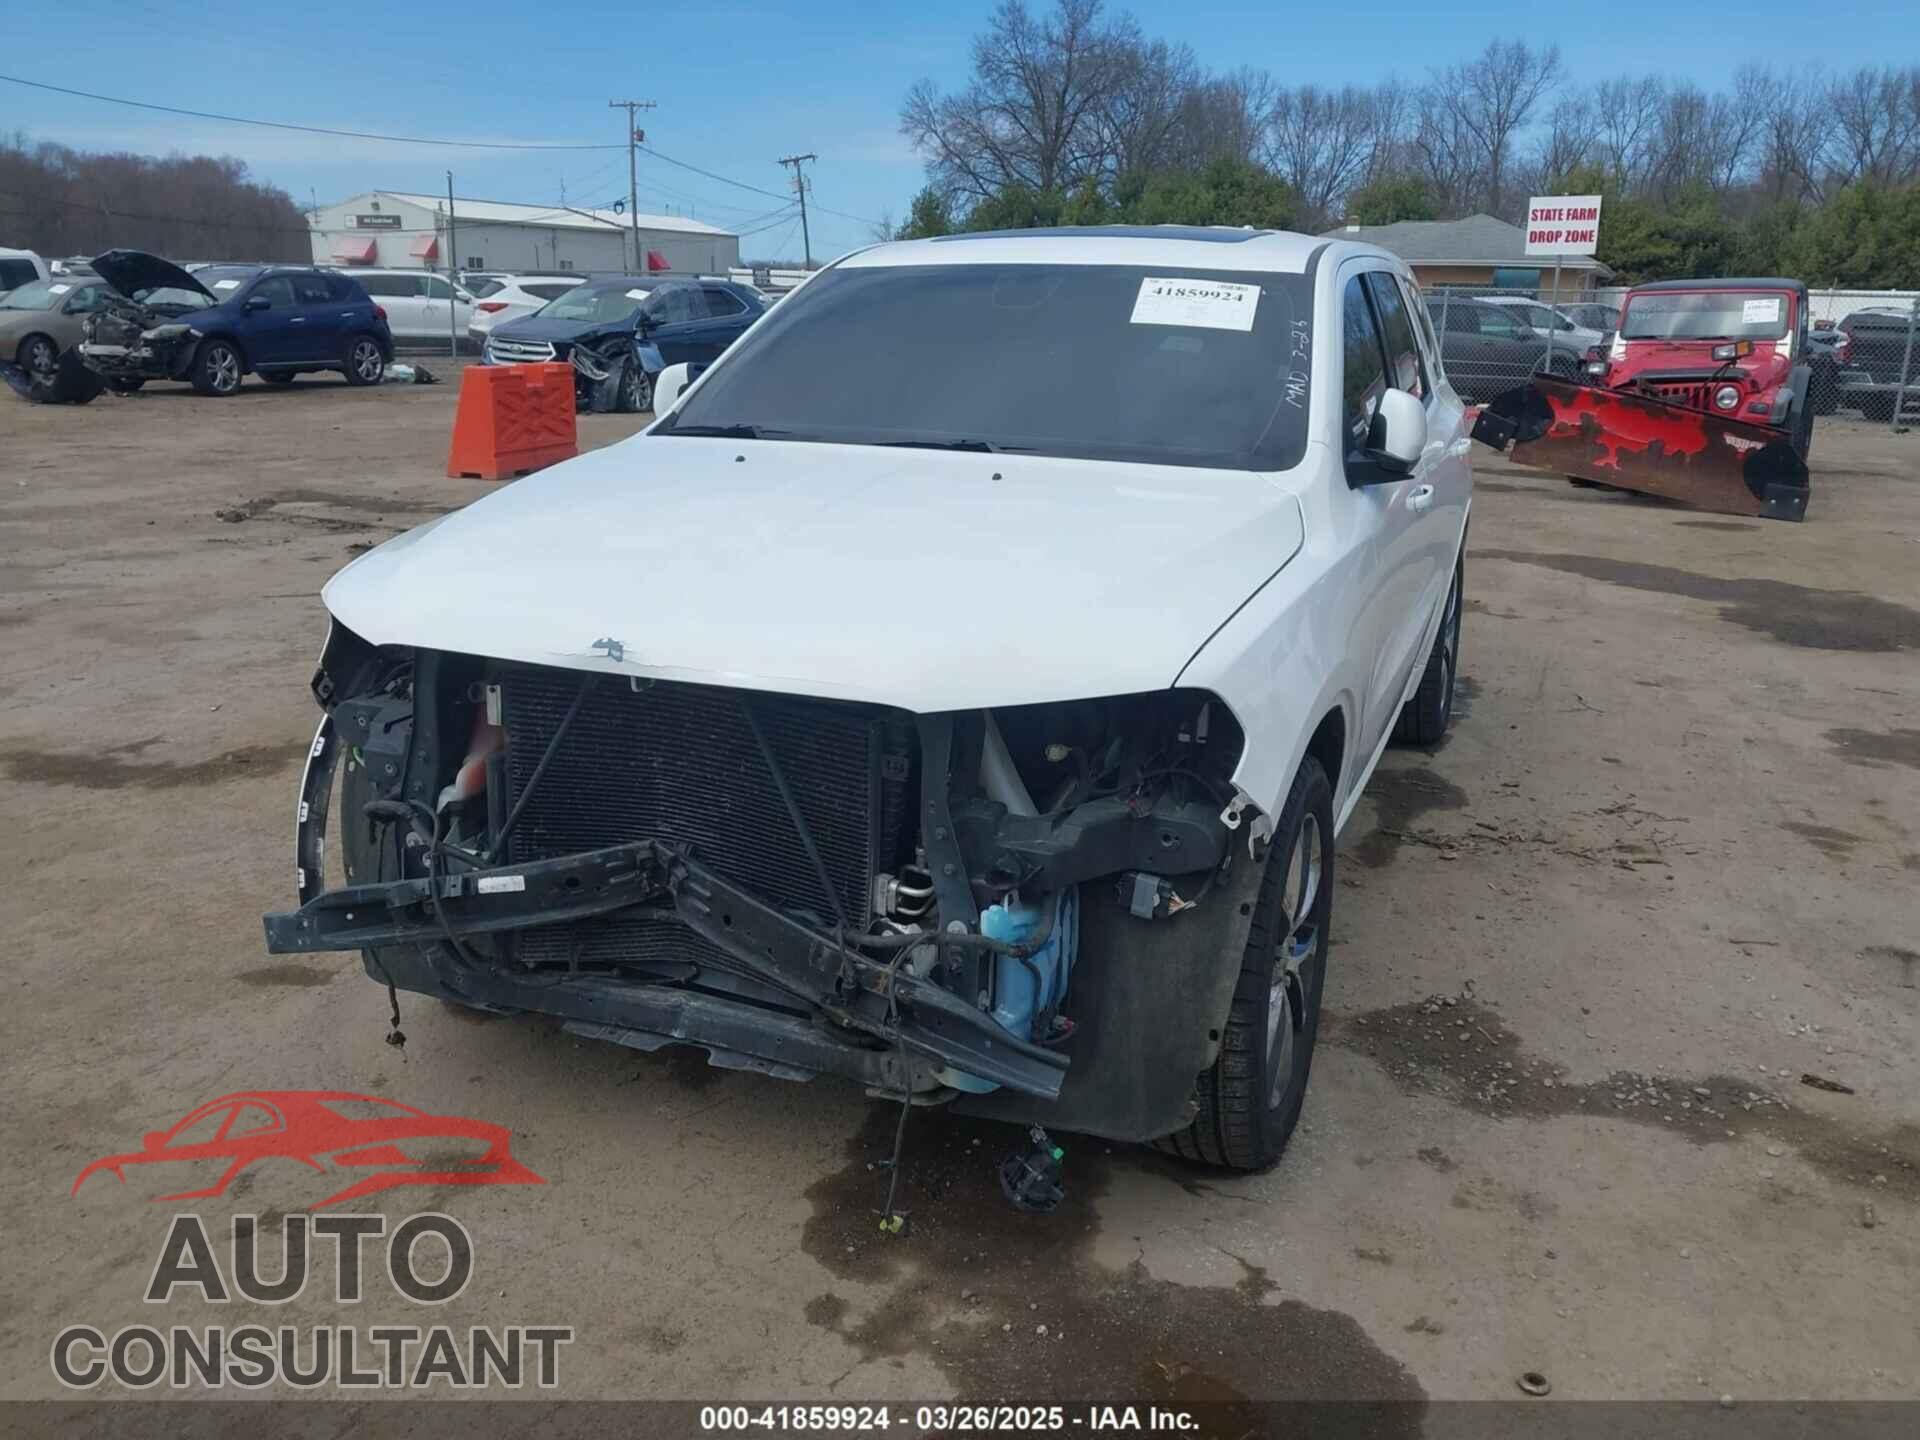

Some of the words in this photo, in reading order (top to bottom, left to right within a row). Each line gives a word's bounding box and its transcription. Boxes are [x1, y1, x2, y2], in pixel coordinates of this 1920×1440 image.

[1531, 208, 1563, 222] STATE
[1566, 207, 1598, 220] FARM
[1529, 230, 1562, 243] DROP
[1564, 230, 1595, 243] ZONE
[1153, 287, 1244, 302] 41859924
